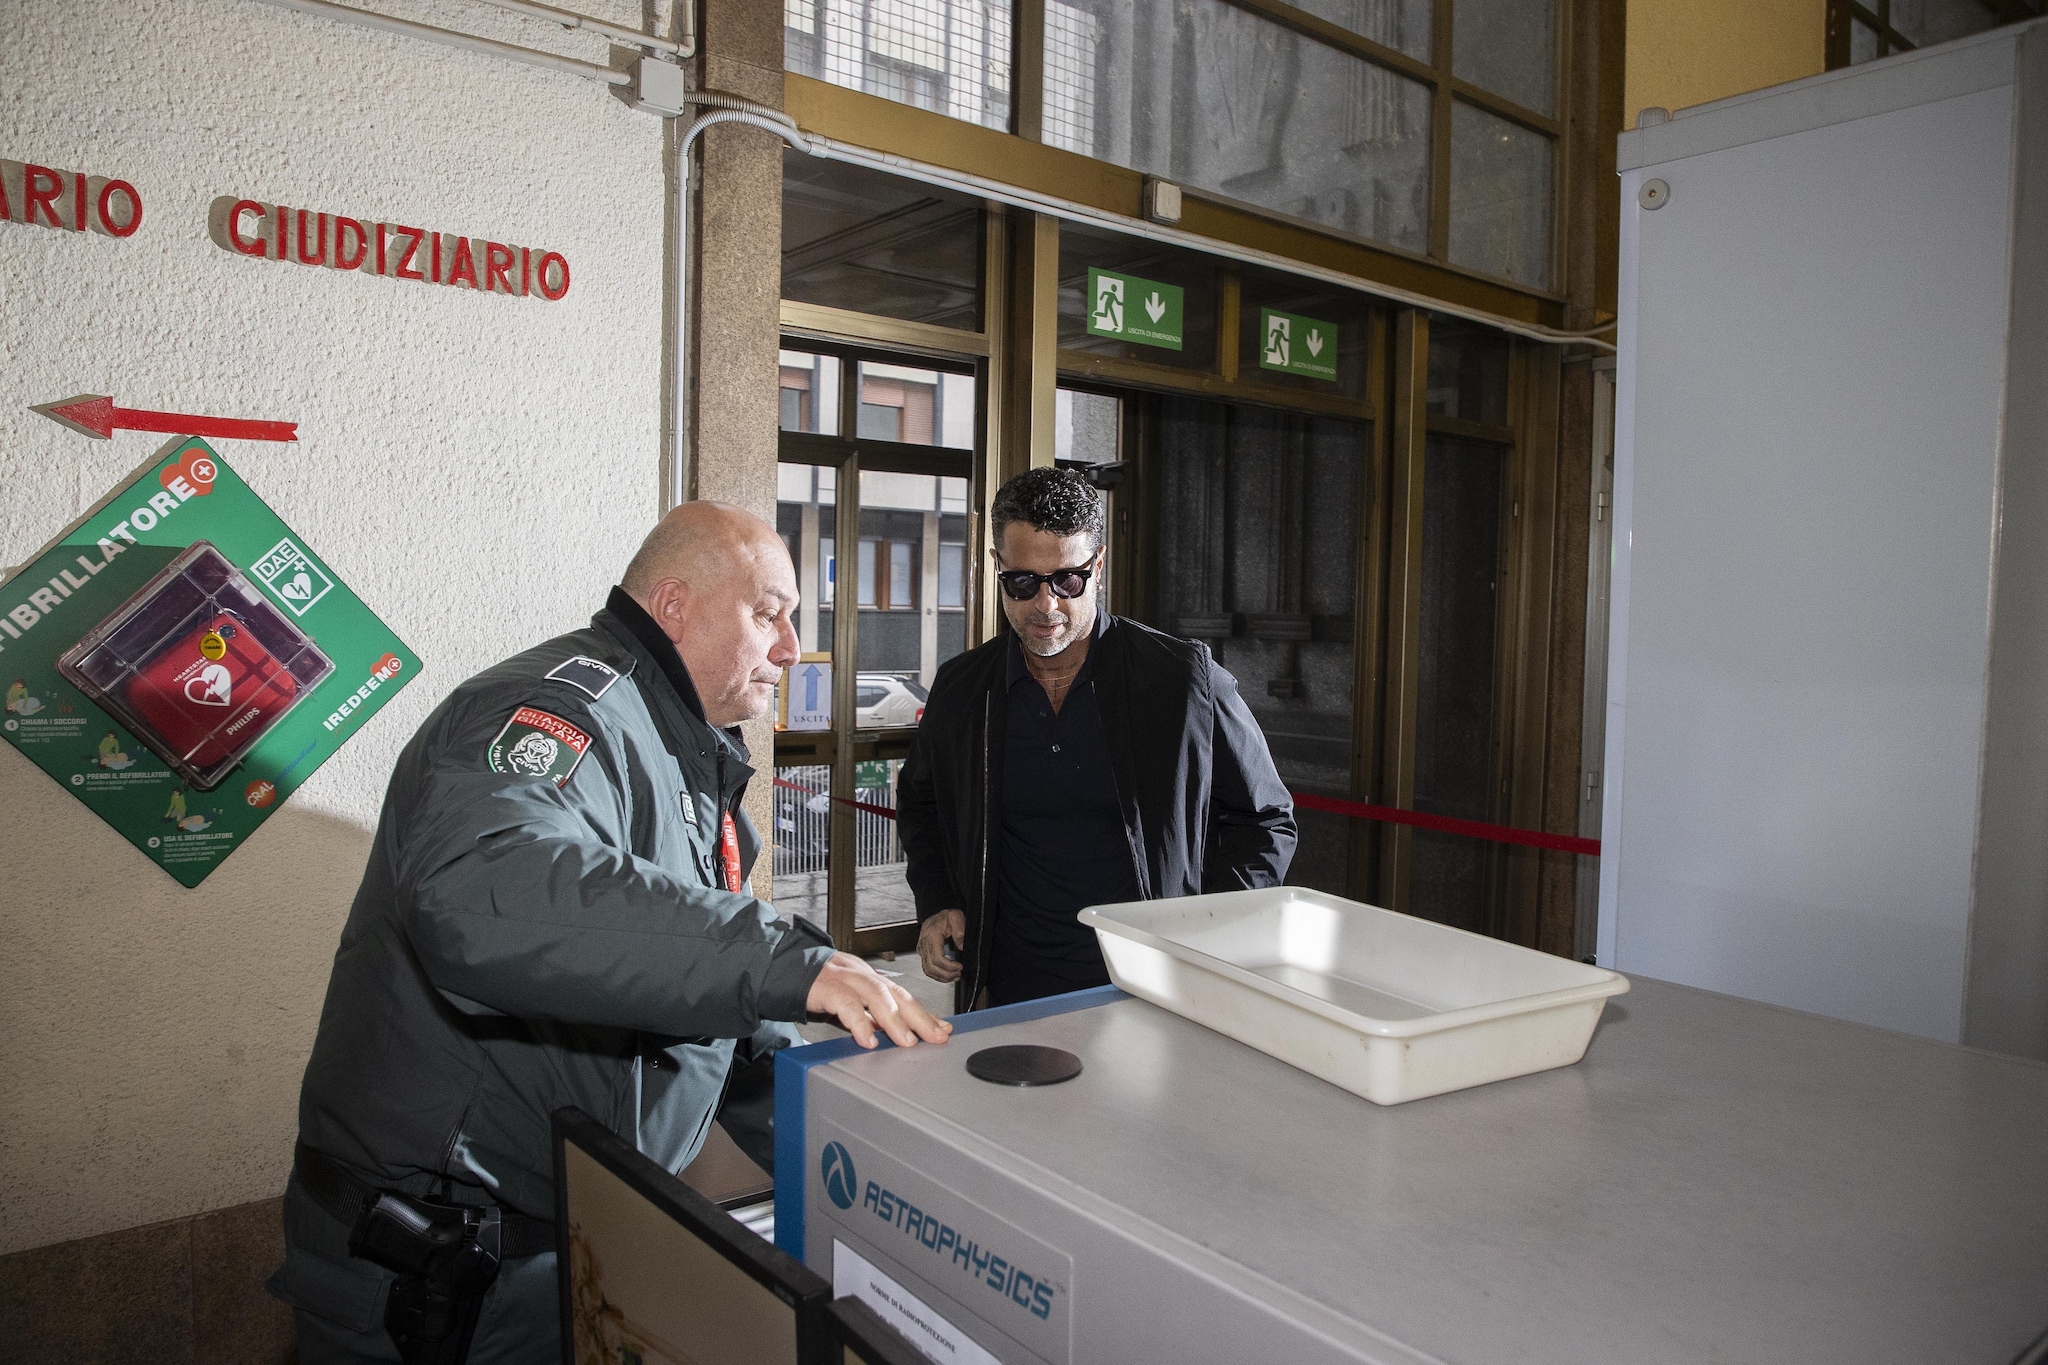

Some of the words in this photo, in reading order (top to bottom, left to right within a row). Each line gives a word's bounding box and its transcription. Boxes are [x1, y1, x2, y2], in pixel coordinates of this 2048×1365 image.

[228, 199, 571, 301] GIUDIZIARIO
[1127, 327, 1146, 336] USCITA
[1151, 331, 1182, 343] EMERGENZA
[0, 475, 198, 651] IBRILLATORE
[258, 544, 297, 578] DAE
[577, 660, 612, 675] CIVIS
[322, 665, 393, 732] IREDEEM
[226, 707, 260, 736] PHILIPS
[517, 717, 582, 750] GIURATA
[521, 711, 585, 743] GUARDIA
[794, 715, 830, 723] USCITA
[119, 771, 171, 779] DEFIBRILLATORE
[515, 757, 540, 773] CIVIS
[247, 782, 275, 806] CRAL
[184, 832, 234, 841] DEFIBRILLATORE
[724, 824, 735, 847] TEAM
[863, 1180, 1054, 1321] ASTROPHYSICS
[869, 1281, 891, 1303] NORME
[891, 1298, 898, 1309] DI
[898, 1304, 956, 1353] RADIOPROTEZIONE
